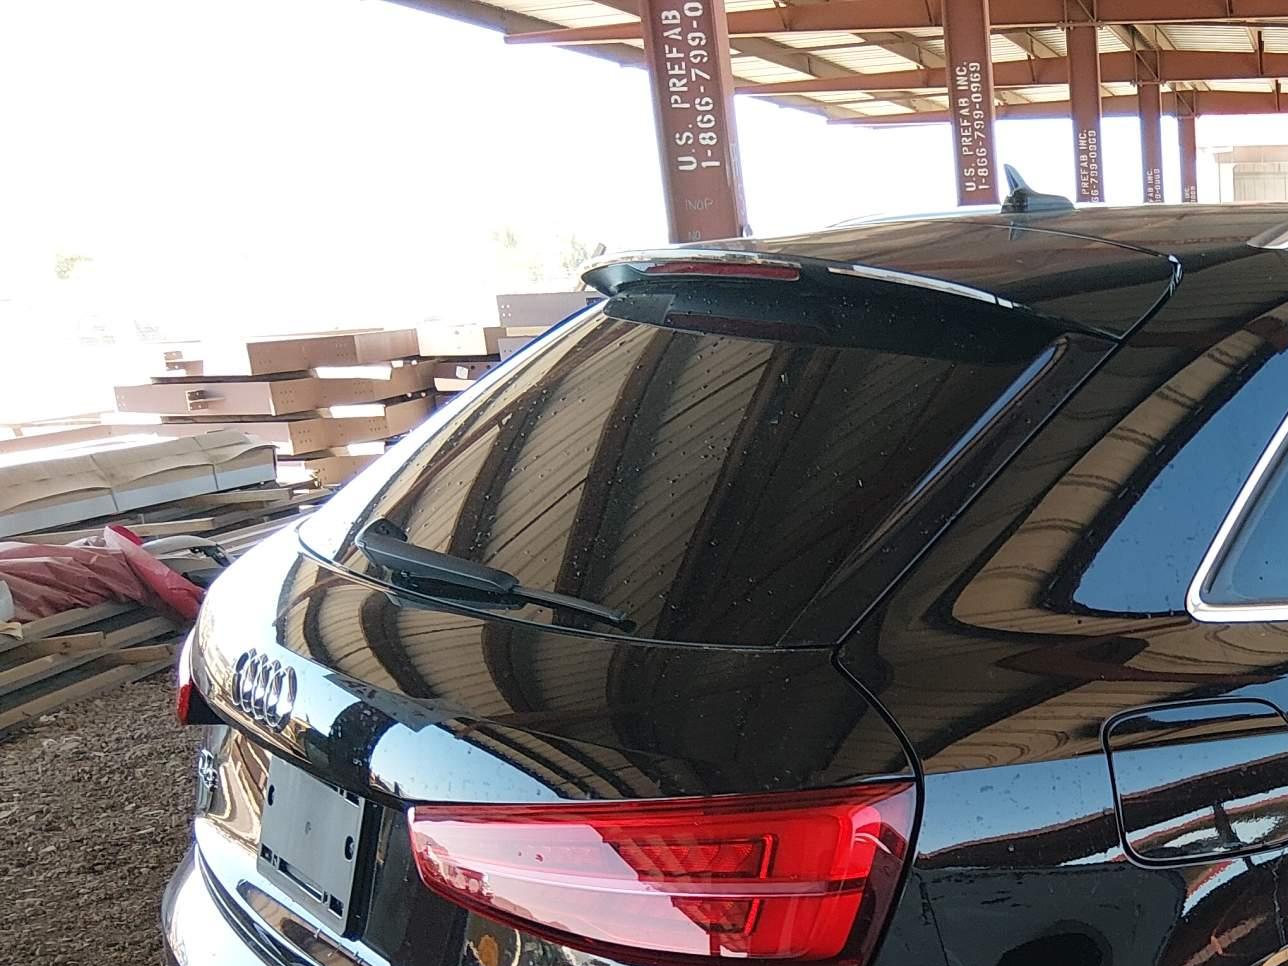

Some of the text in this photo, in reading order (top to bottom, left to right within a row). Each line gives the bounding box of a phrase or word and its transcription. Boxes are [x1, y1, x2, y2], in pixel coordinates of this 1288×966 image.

[661, 9, 698, 171] U.S. PREFAB
[955, 61, 976, 191] U.S. PREFAB INC.
[1078, 129, 1089, 195] PREFAB INC.
